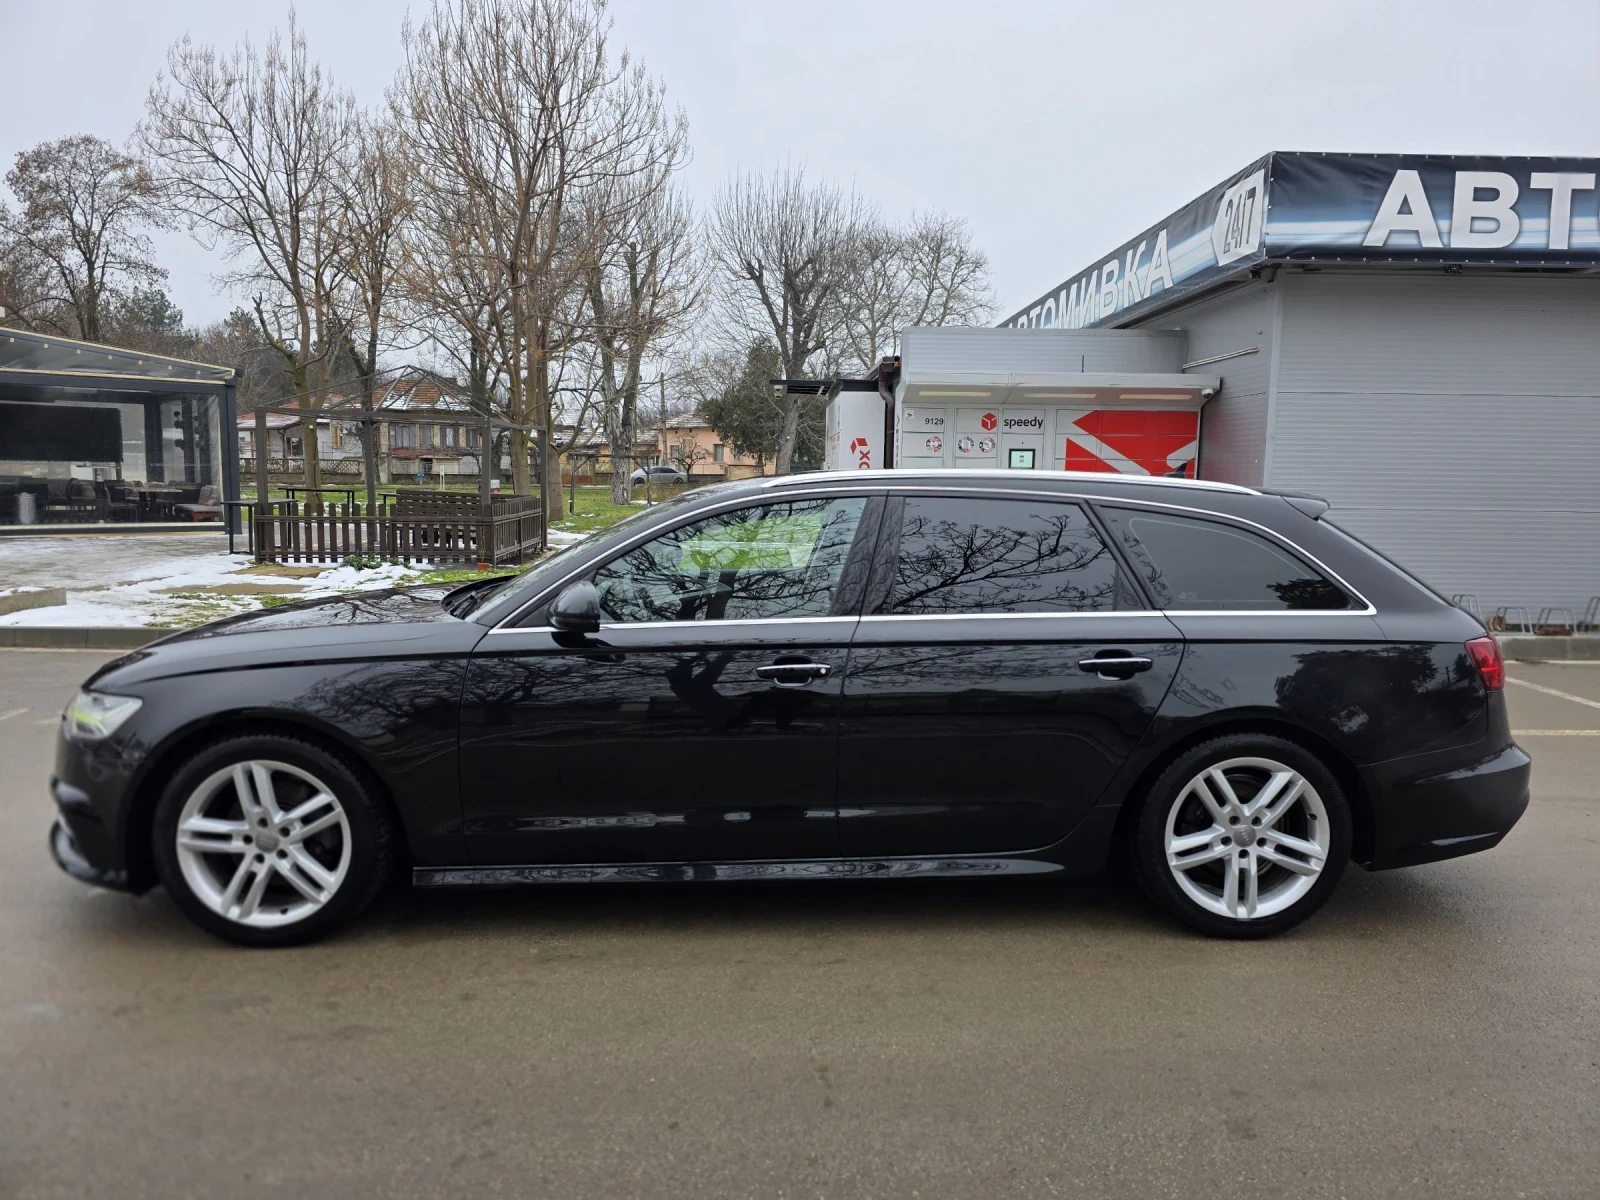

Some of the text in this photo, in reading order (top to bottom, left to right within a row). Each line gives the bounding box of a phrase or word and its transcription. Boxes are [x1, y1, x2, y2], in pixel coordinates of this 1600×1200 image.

[1223, 186, 1257, 254] 24/7
[1362, 169, 1600, 250] АВТ
[1008, 228, 1174, 329] ТОМИВКА
[925, 417, 944, 425] 9129
[1003, 416, 1044, 429] speedy
